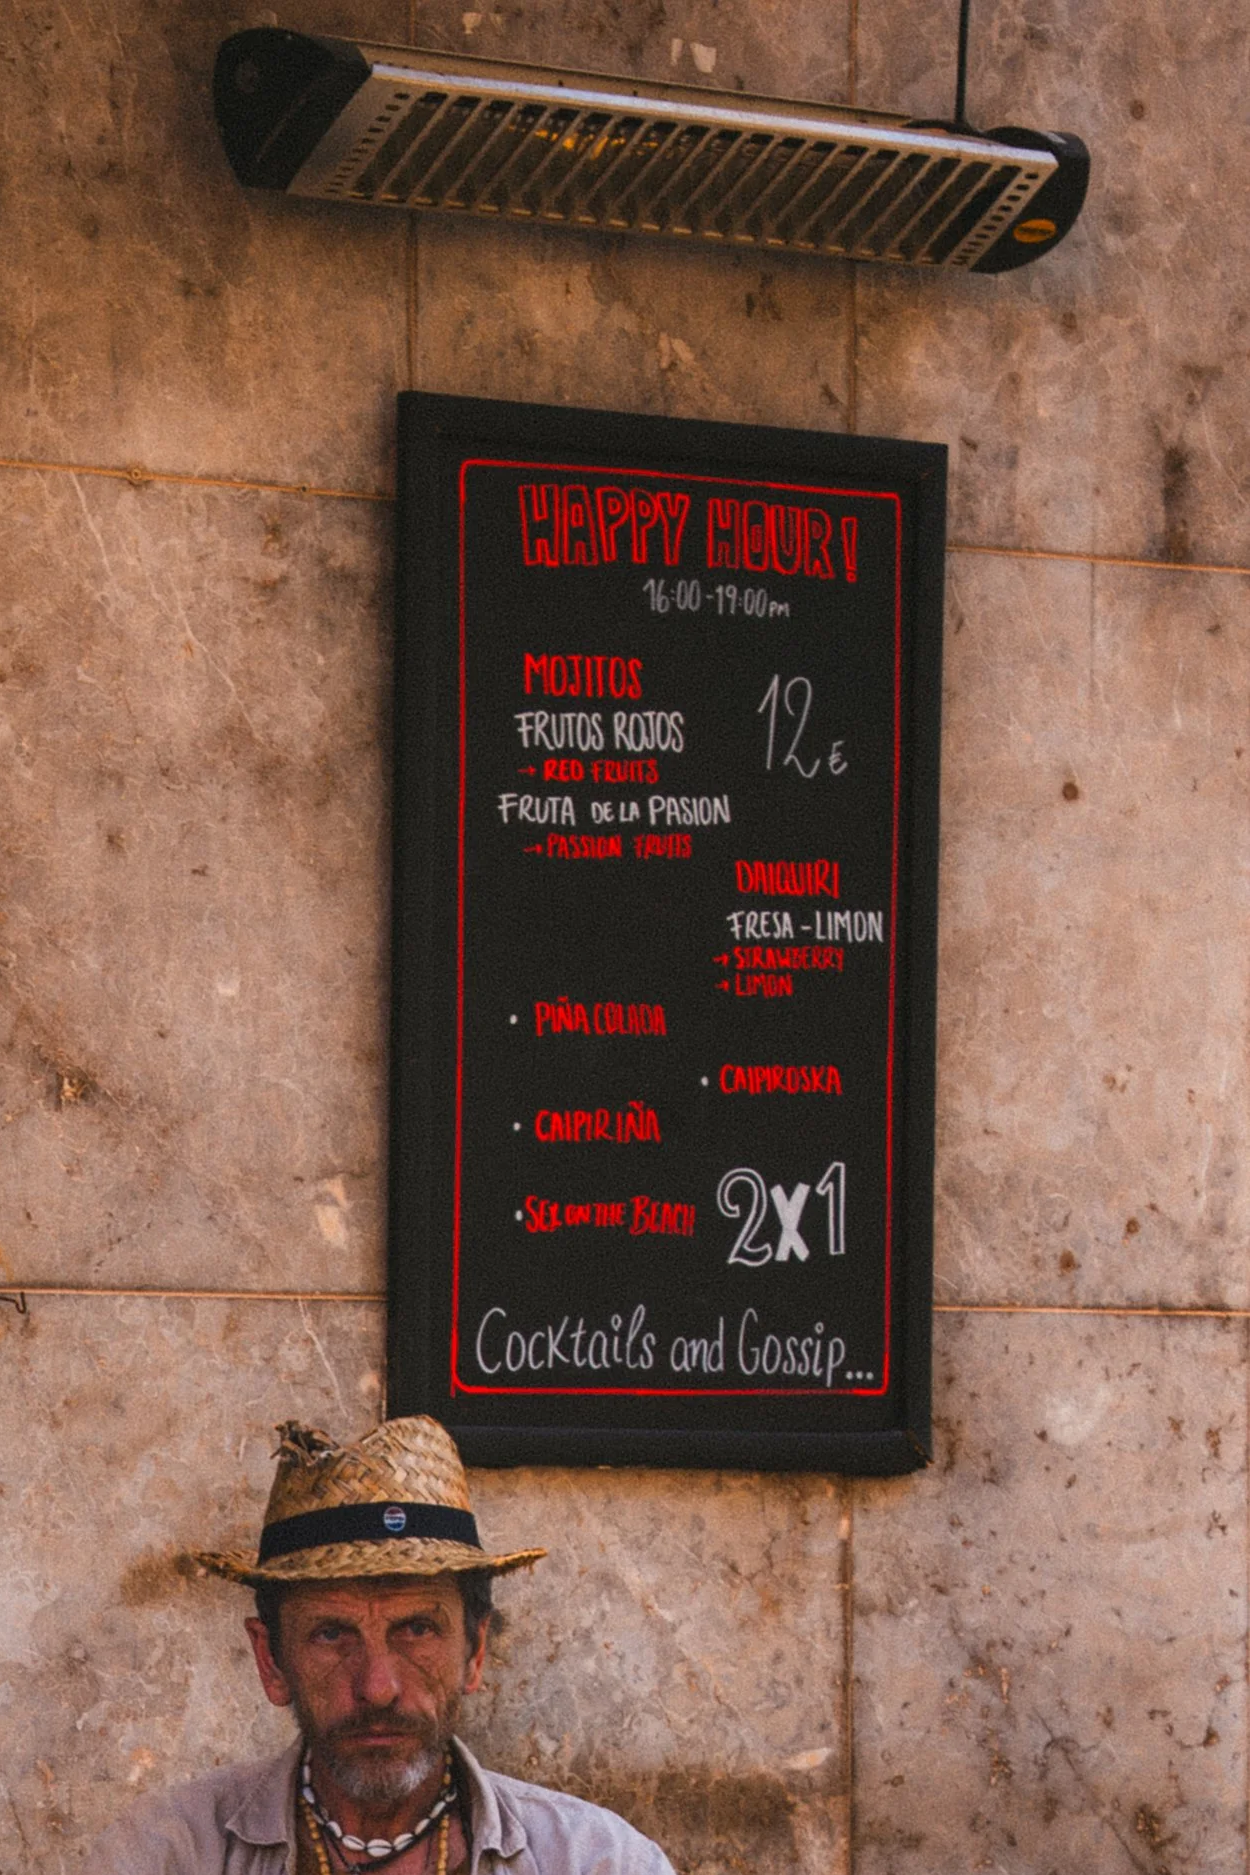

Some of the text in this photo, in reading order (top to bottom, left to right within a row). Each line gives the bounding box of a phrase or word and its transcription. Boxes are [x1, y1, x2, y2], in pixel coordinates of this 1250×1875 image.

[517, 484, 690, 567] HAPPY
[523, 652, 644, 700] MOJITOS
[513, 710, 685, 753] FRUTOS ROJOS
[542, 758, 661, 785] RED FRUITS
[497, 793, 732, 827] FRUTA DE LA PASION
[547, 832, 693, 860] PASSION FRUITS
[734, 858, 841, 900] DAIQUIRI
[726, 910, 795, 941] FRESA
[732, 945, 845, 972] STRAWBERRY
[734, 973, 794, 998] LIMON
[534, 996, 668, 1037] PIÑA COLADA
[719, 1063, 843, 1095] CAIPIROSKA
[534, 1100, 662, 1144] CAIPIRIÑA
[524, 1194, 562, 1234] SEX
[669, 1315, 726, 1373] and
